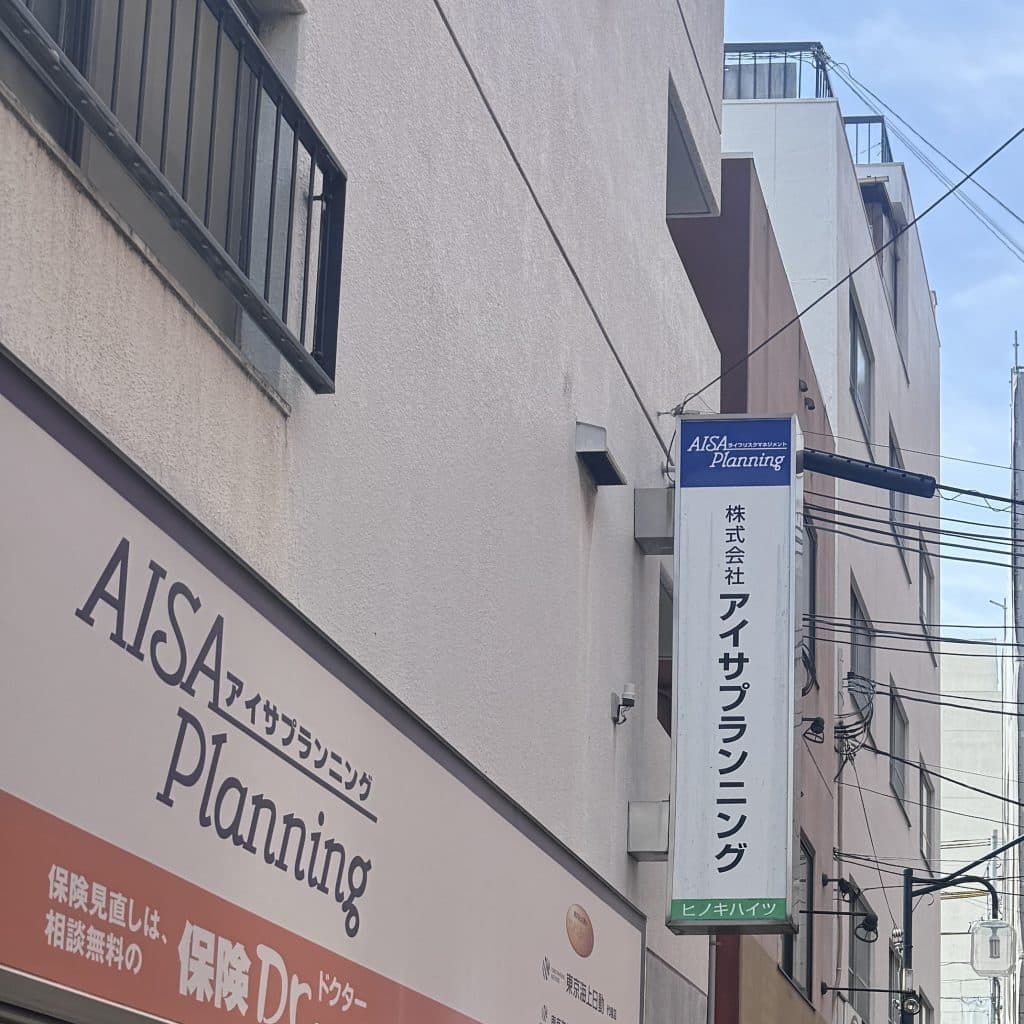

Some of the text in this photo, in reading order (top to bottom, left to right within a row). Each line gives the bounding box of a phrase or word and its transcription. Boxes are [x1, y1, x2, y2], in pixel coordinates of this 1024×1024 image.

[687, 435, 727, 451] AISA
[709, 451, 785, 471] Planning
[75, 537, 224, 714] AISA
[715, 504, 751, 873] 株式会社 アイサプランニング
[226, 671, 373, 801] アイサプランニング
[156, 707, 372, 938] Planning
[48, 864, 167, 944] 保険見直しは、
[682, 903, 777, 917] ヒノキハイツ
[44, 908, 142, 975] 相談無料の
[318, 971, 367, 1012] ドクター
[566, 972, 604, 1015] 東京海上日動
